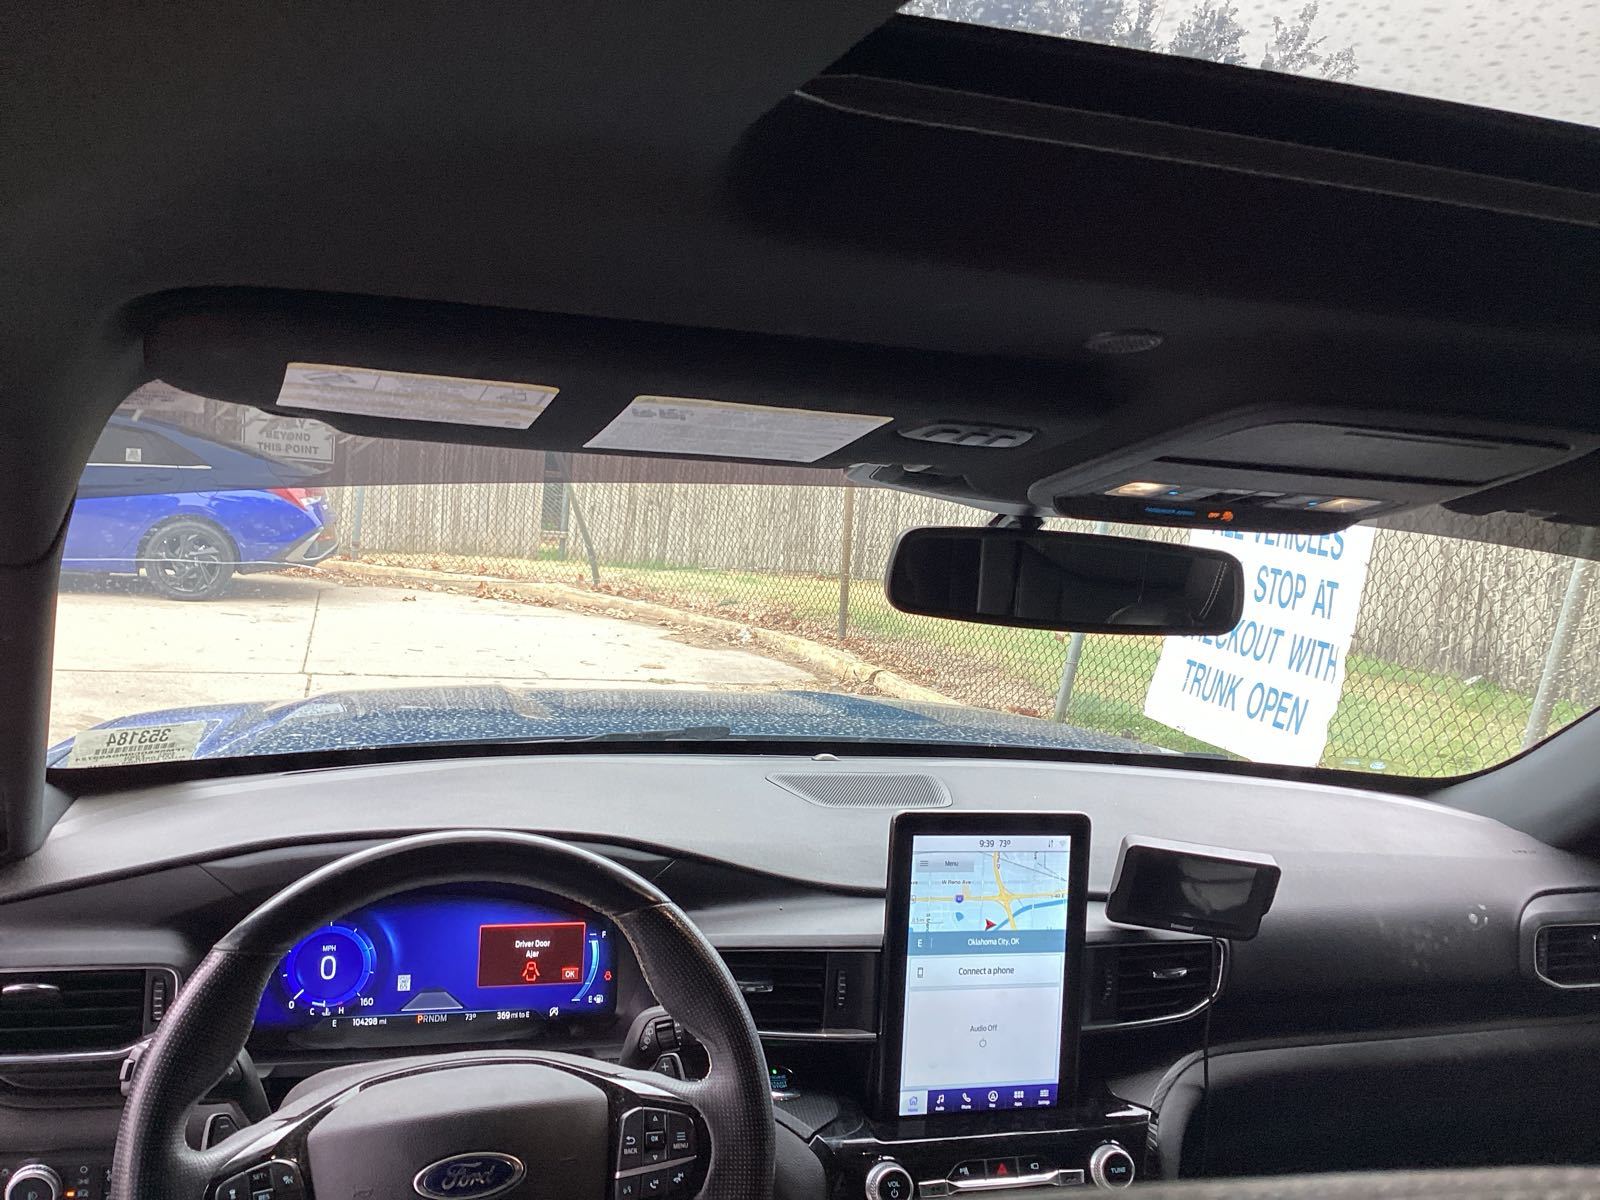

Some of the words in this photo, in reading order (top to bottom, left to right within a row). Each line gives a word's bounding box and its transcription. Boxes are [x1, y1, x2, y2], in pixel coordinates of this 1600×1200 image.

[265, 430, 311, 442] BEYOND
[256, 441, 282, 451] THIS
[285, 443, 319, 455] POINT
[1254, 565, 1307, 611] STOP
[1312, 579, 1339, 620] AT
[1287, 633, 1340, 684] WITH
[1182, 659, 1244, 711] TRUNK
[1246, 682, 1310, 735] OPEN
[979, 839, 995, 848] 9:39
[514, 940, 535, 948] Driver
[535, 939, 551, 948] Door
[917, 939, 923, 947] E
[967, 938, 998, 946] Oklahoma
[1011, 937, 1020, 945] OK
[322, 944, 337, 952] MPH
[525, 950, 539, 958] Ajar
[320, 955, 337, 980] 0
[958, 967, 986, 975] Connect
[992, 966, 1015, 976] phone
[565, 970, 575, 978] OK
[288, 1001, 294, 1009] 0
[360, 998, 373, 1006] 160
[309, 1008, 315, 1016] C
[338, 1007, 344, 1015] H
[496, 1011, 510, 1020] 369
[332, 1020, 337, 1028] E
[352, 1018, 378, 1026] 104298
[970, 1024, 987, 1032] Audio
[987, 1024, 998, 1032] Off
[672, 1142, 689, 1150] MENU
[623, 1147, 638, 1155] BACK
[1110, 1166, 1126, 1174] TUNE
[441, 1161, 496, 1191] Ford
[887, 1180, 900, 1188] VOL
